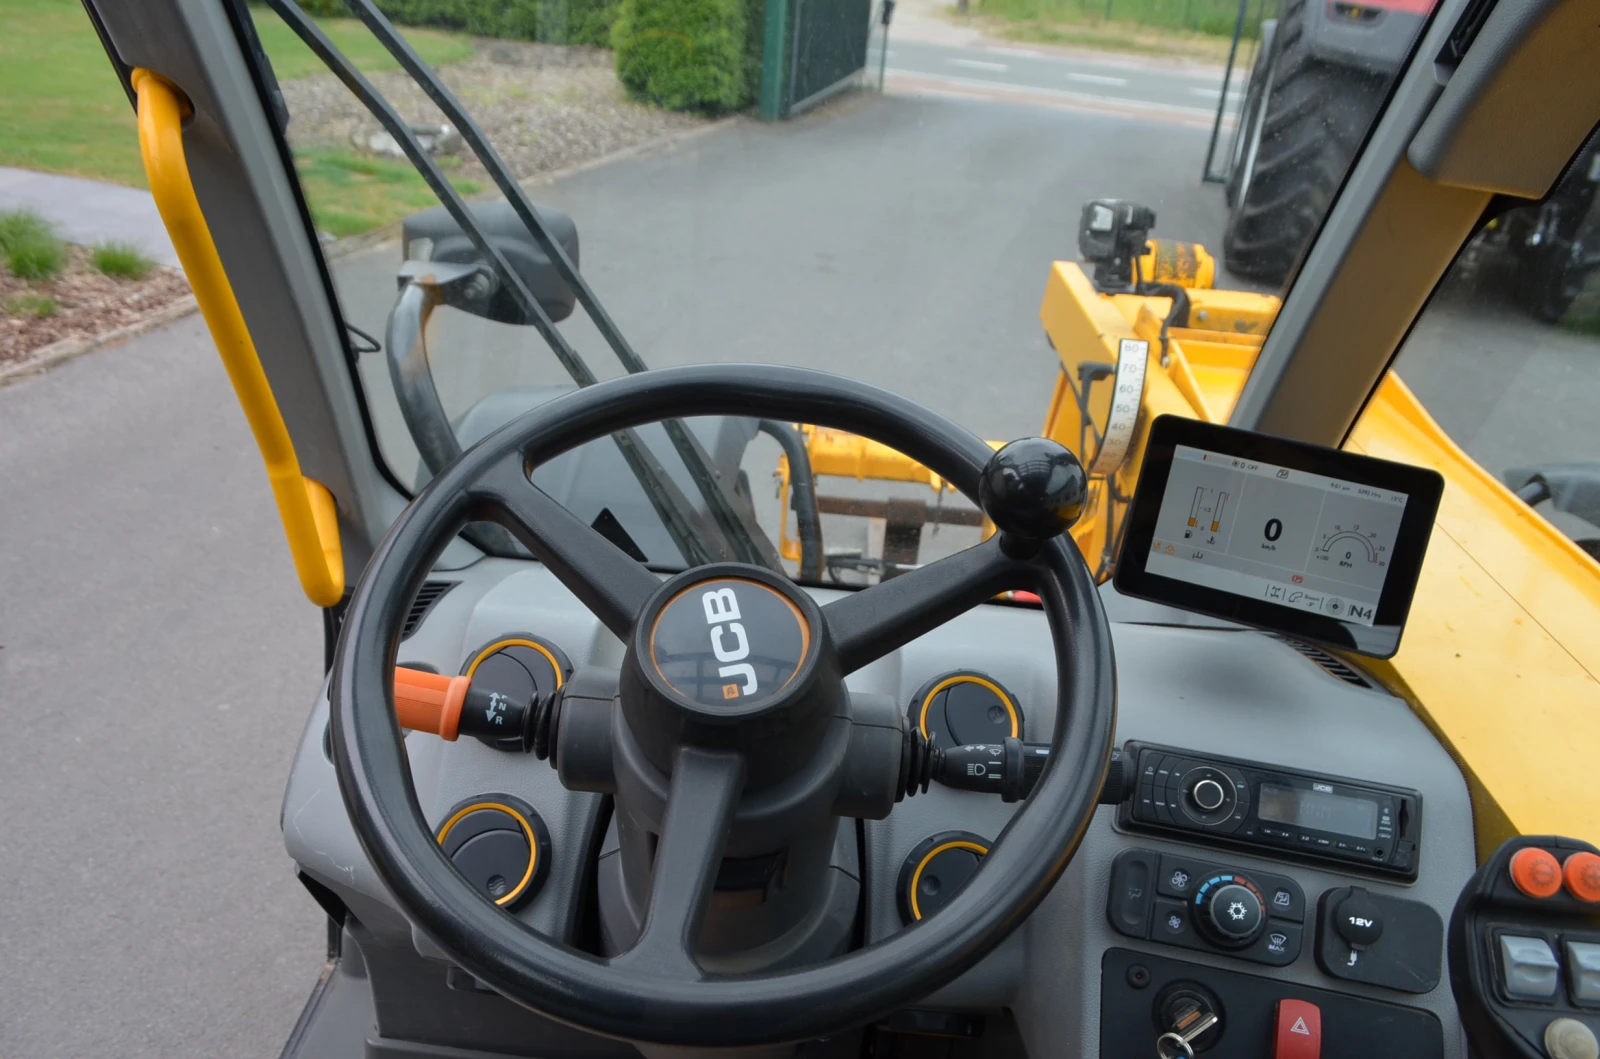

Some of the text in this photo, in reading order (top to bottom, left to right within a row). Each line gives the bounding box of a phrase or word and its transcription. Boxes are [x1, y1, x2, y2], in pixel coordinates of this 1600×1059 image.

[1122, 363, 1138, 373] 70
[1119, 384, 1135, 394] 60
[1115, 404, 1131, 413] 50
[1112, 422, 1127, 431] 40
[1264, 518, 1283, 542] 0
[1261, 543, 1277, 551] km/h
[1345, 551, 1352, 560] 0
[1339, 560, 1353, 569] RPM
[1350, 604, 1373, 621] N4
[702, 587, 758, 696] JCB
[498, 702, 507, 711] N
[495, 715, 503, 725] R
[1348, 916, 1373, 928] 12V
[1268, 944, 1286, 953] MAX
